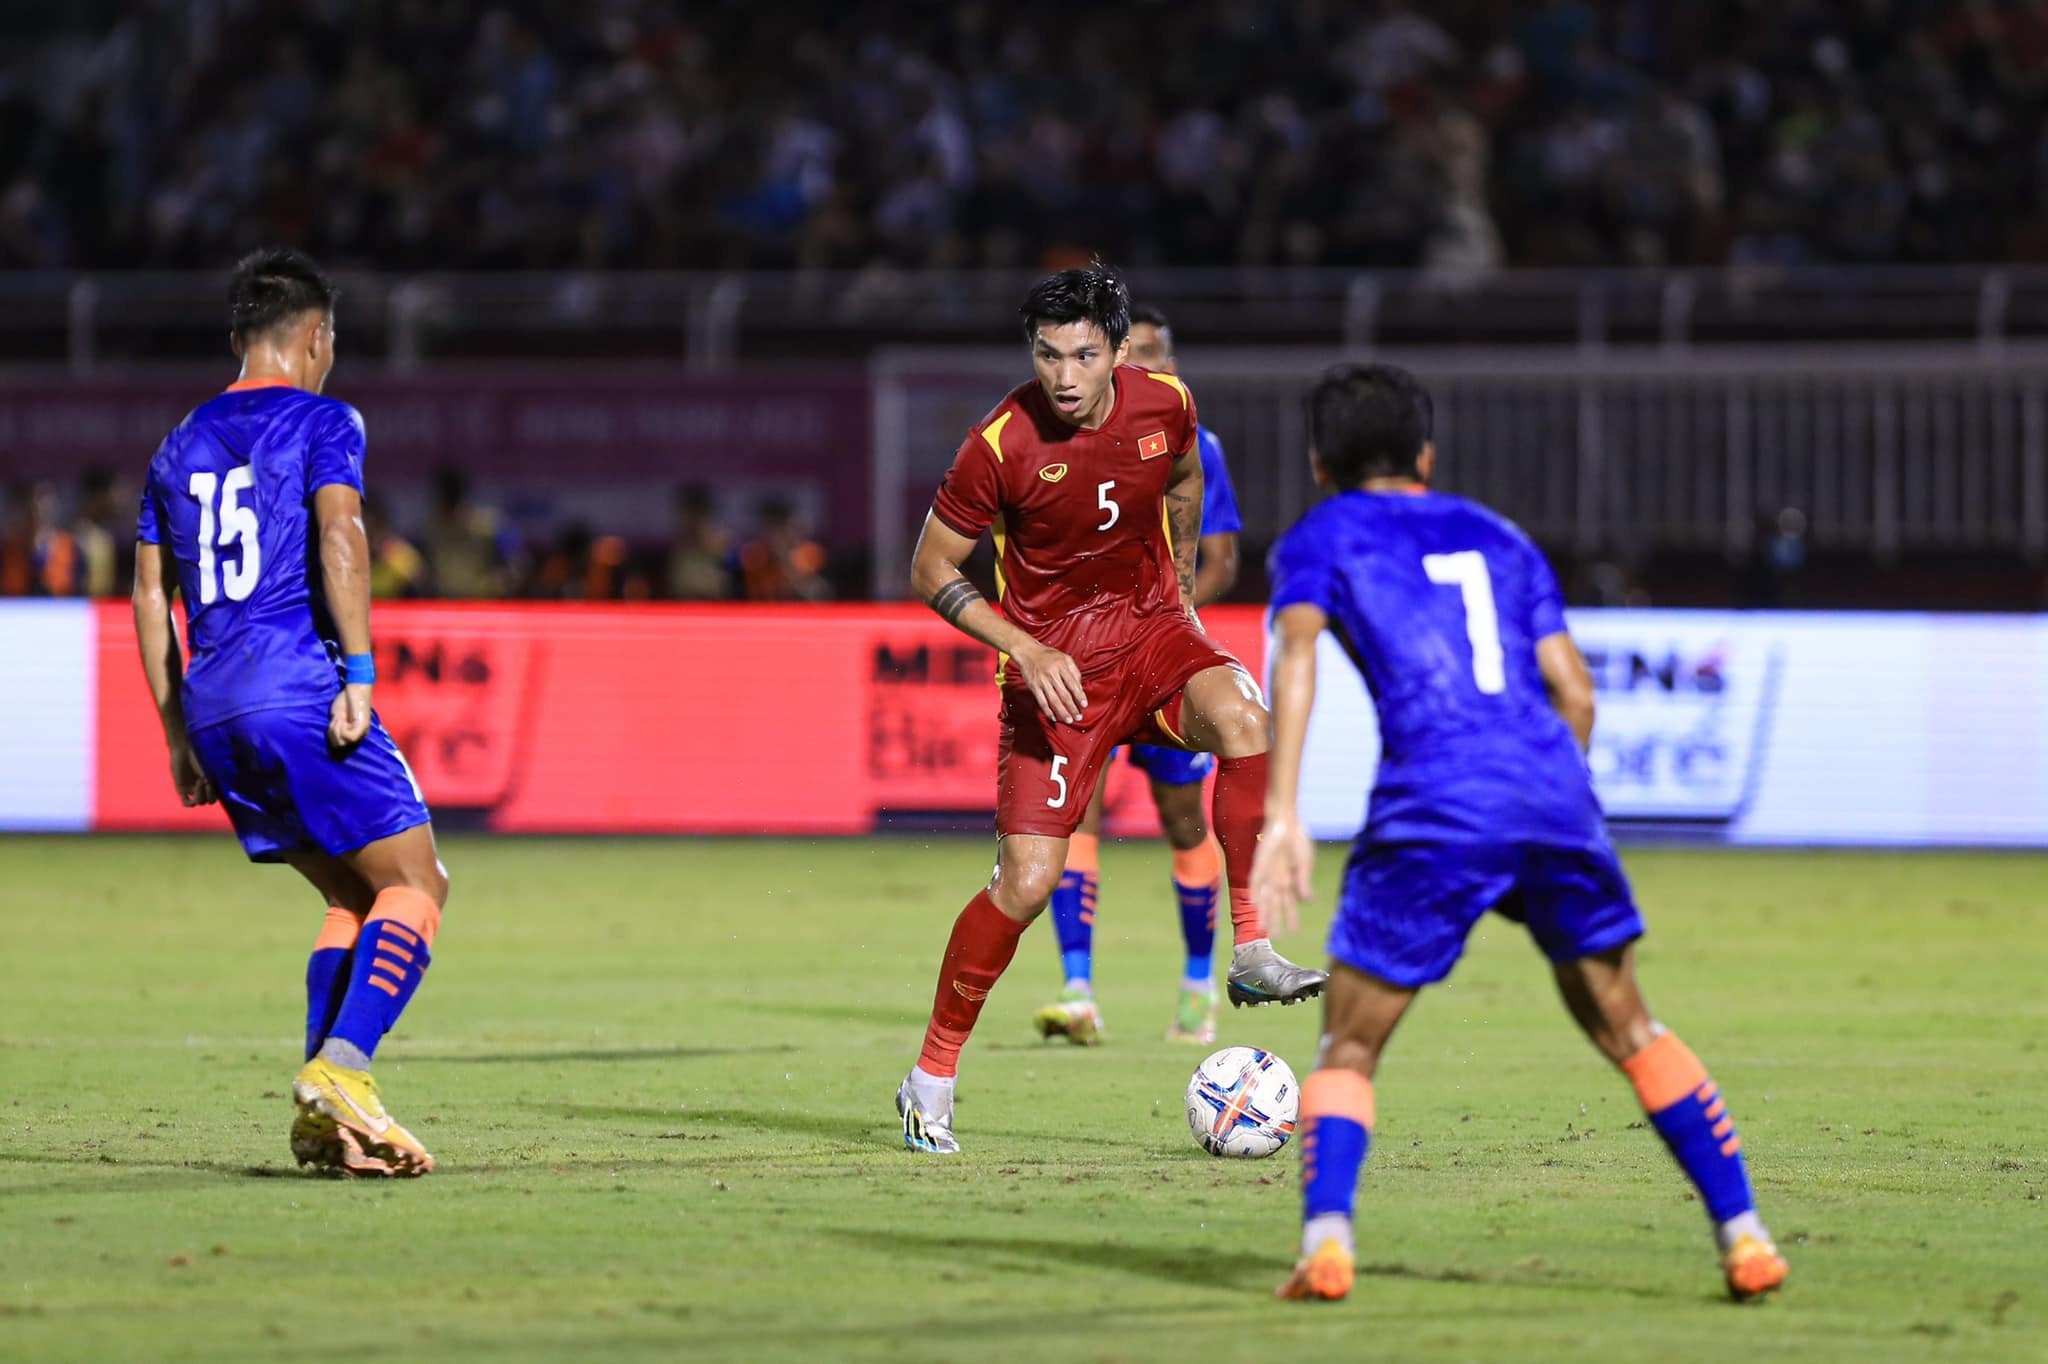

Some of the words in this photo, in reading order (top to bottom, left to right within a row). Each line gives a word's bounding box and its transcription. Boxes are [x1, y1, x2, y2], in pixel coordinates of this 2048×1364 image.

[189, 464, 261, 605] 15
[1097, 480, 1119, 531] 5
[1421, 550, 1506, 694] 7
[1047, 755, 1068, 809] 5
